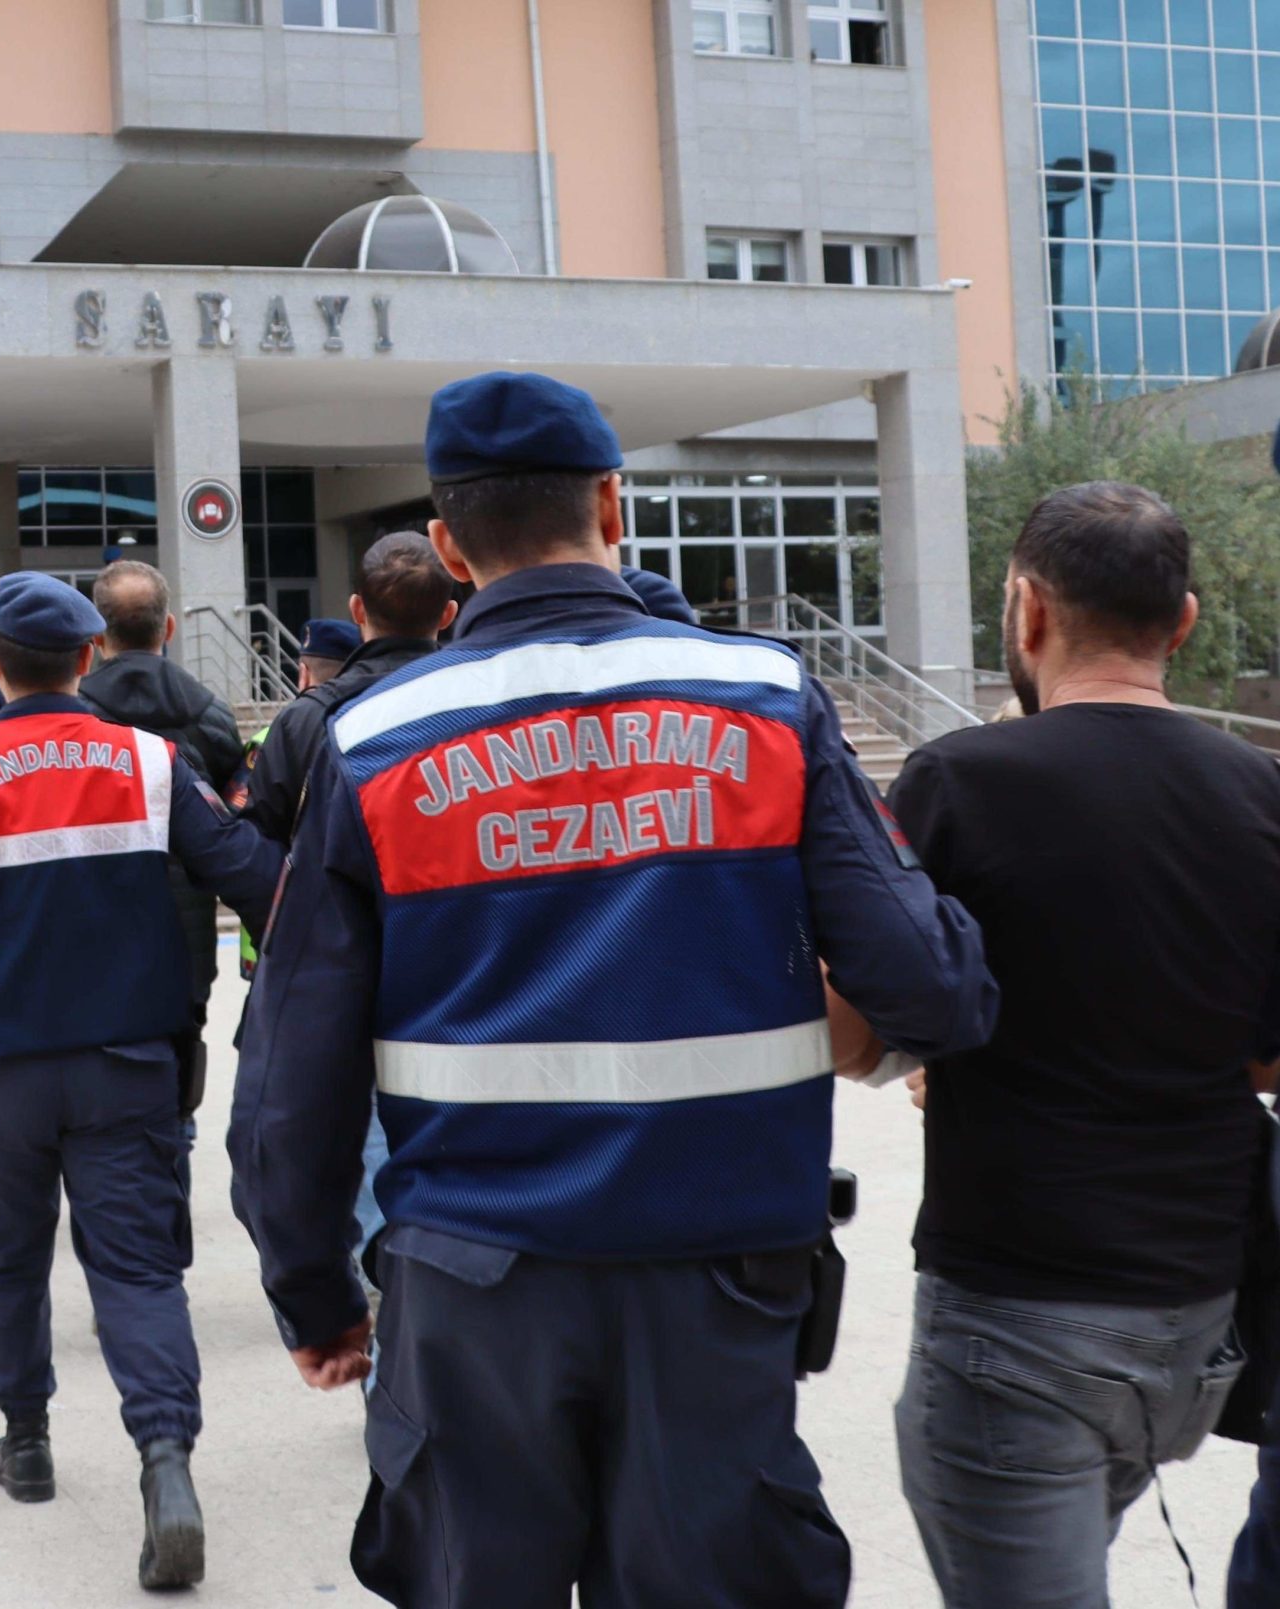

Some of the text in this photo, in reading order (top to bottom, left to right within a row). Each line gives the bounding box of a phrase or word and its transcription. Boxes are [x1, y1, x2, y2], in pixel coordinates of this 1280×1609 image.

[73, 289, 394, 350] SARAYI
[415, 711, 748, 816] JANDARMA
[477, 776, 715, 871] CEZAEVİ
